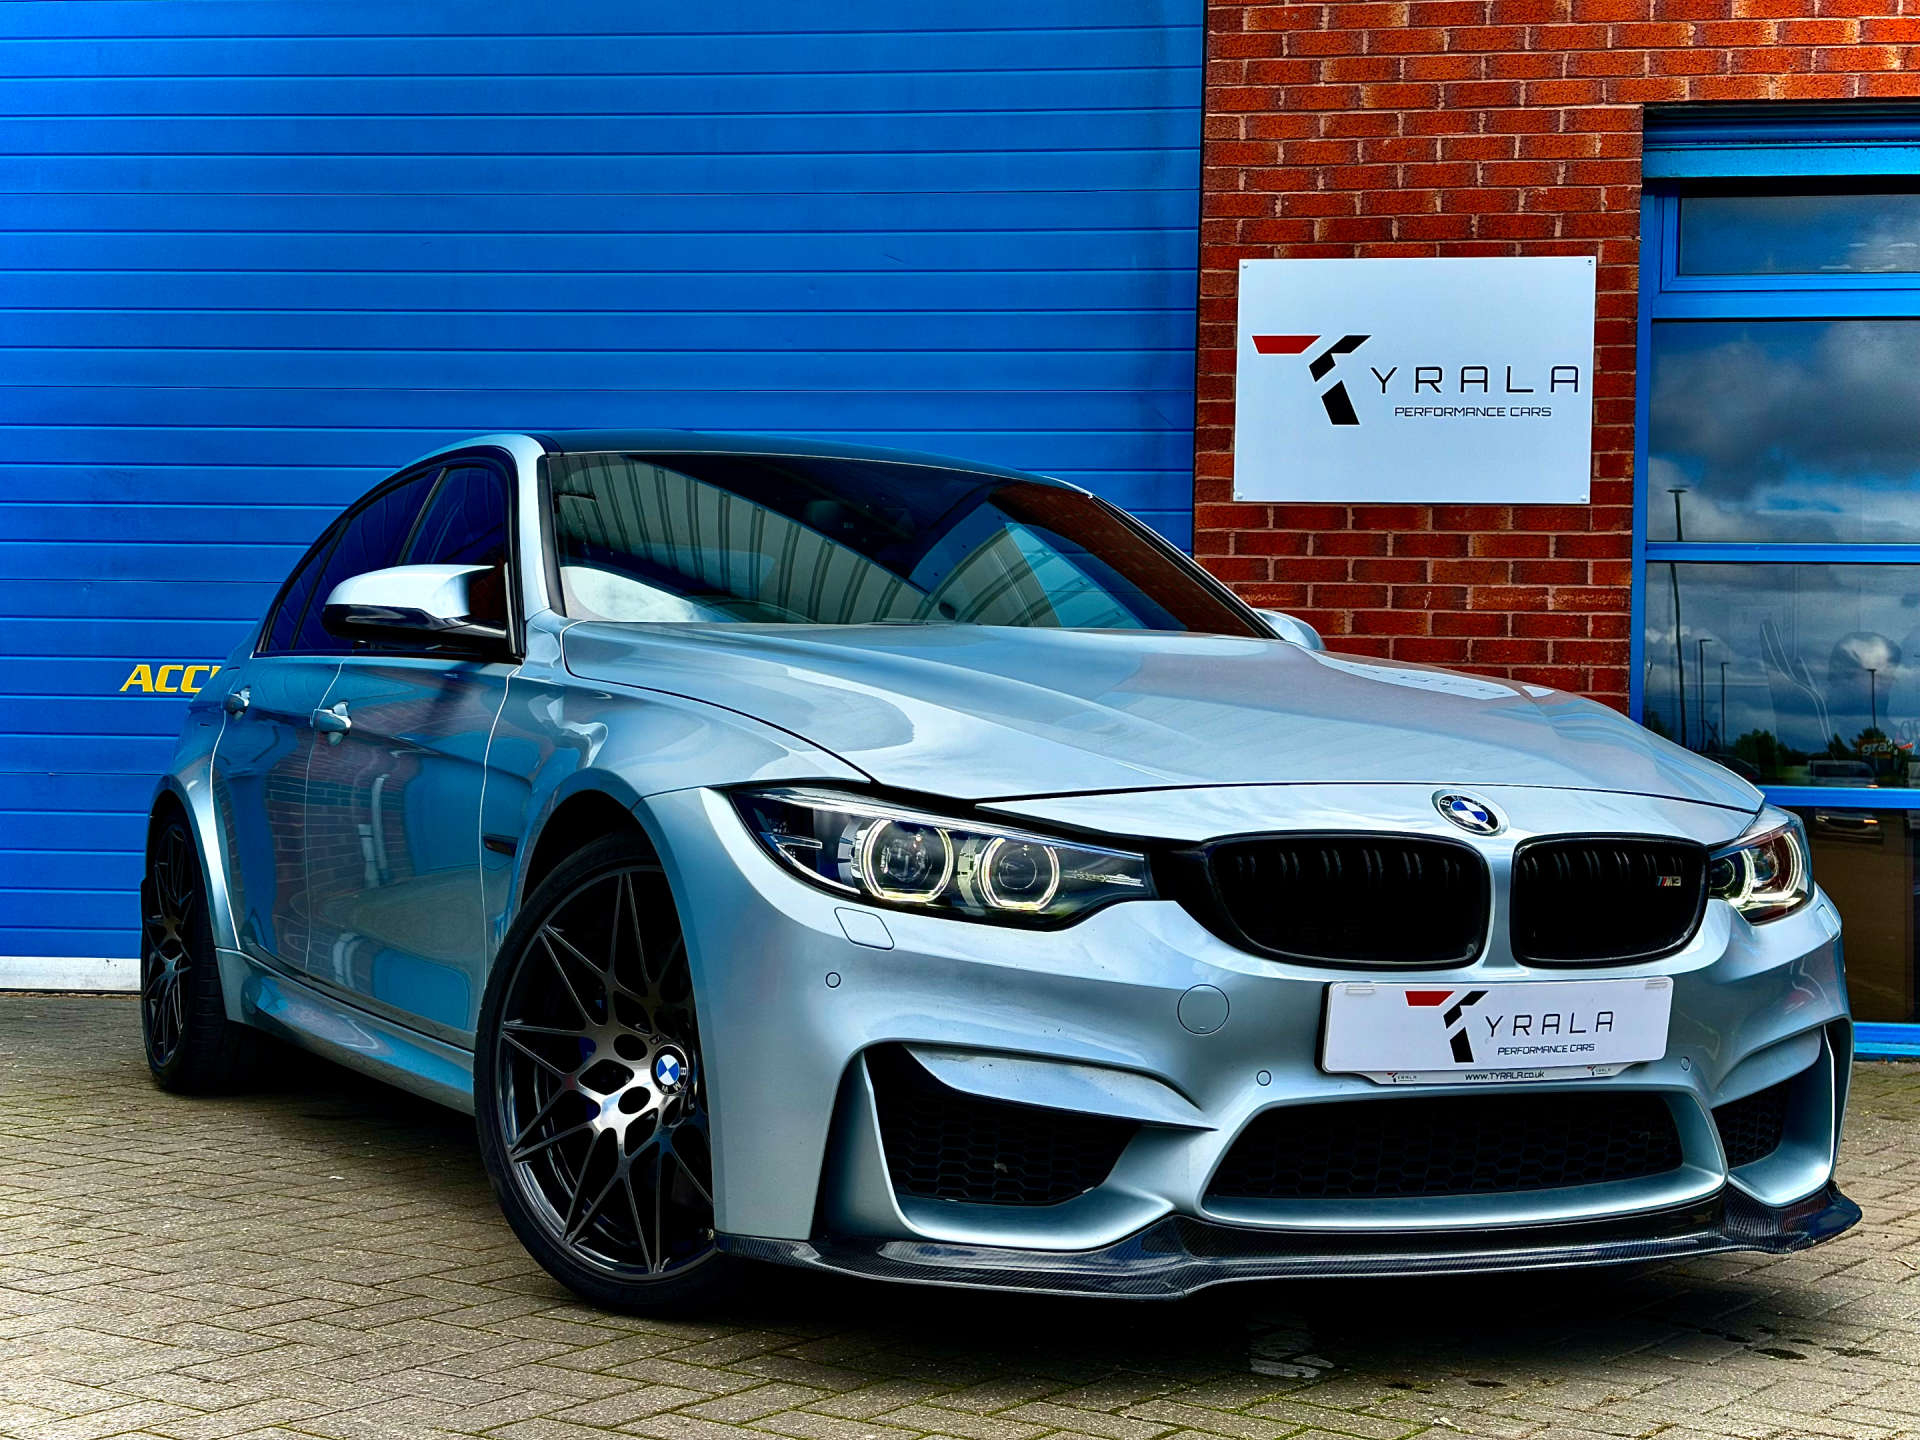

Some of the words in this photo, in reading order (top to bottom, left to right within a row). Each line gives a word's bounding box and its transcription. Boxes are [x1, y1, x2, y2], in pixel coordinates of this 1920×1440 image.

[1394, 407, 1506, 417] PERFORMANCE
[1510, 407, 1552, 417] CARS
[1497, 1046, 1568, 1056] PERFORMANCE
[1569, 1043, 1595, 1053] CARS
